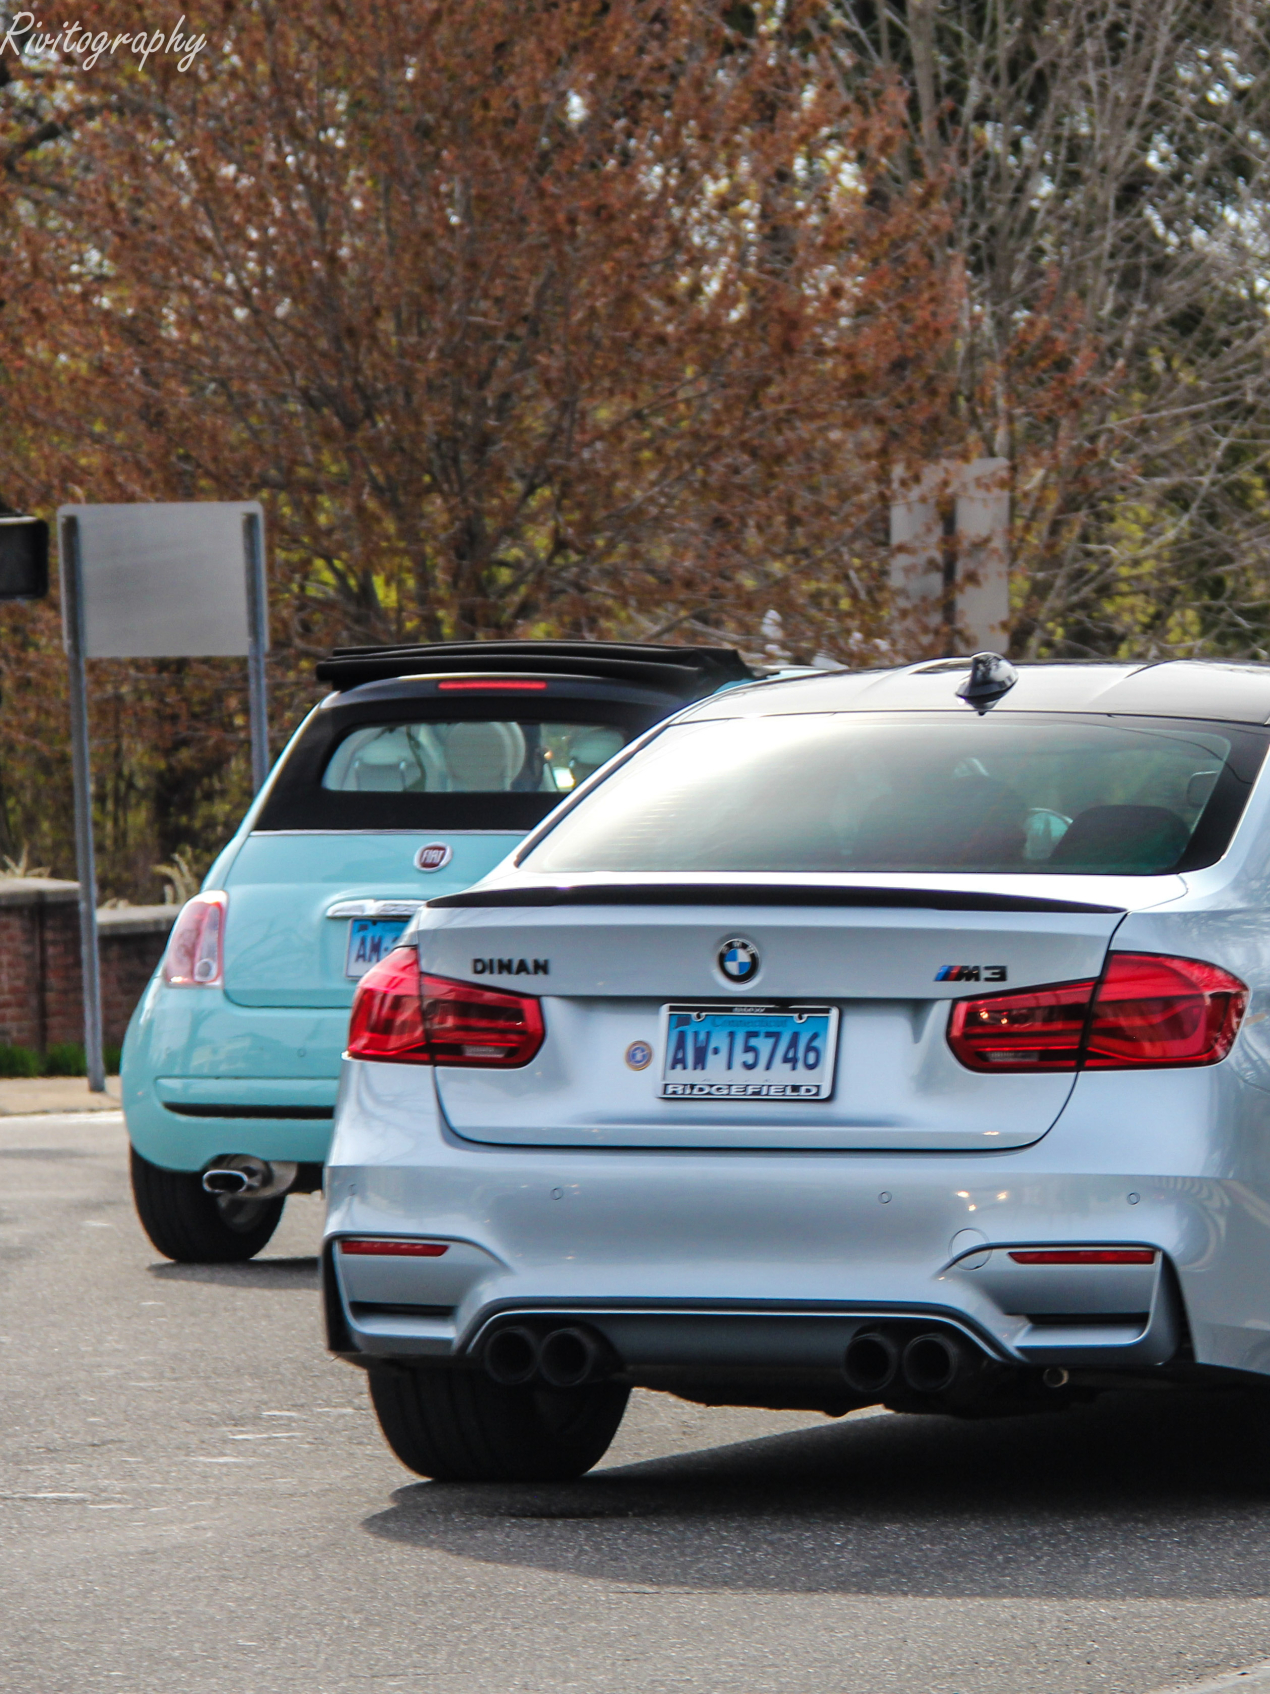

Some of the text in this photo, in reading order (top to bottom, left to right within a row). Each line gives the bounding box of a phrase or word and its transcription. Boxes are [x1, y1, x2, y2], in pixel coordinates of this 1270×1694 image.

[421, 849, 444, 864] FIAT
[473, 958, 549, 975] DINAN
[667, 1085, 818, 1096] RIDGEFIELD
